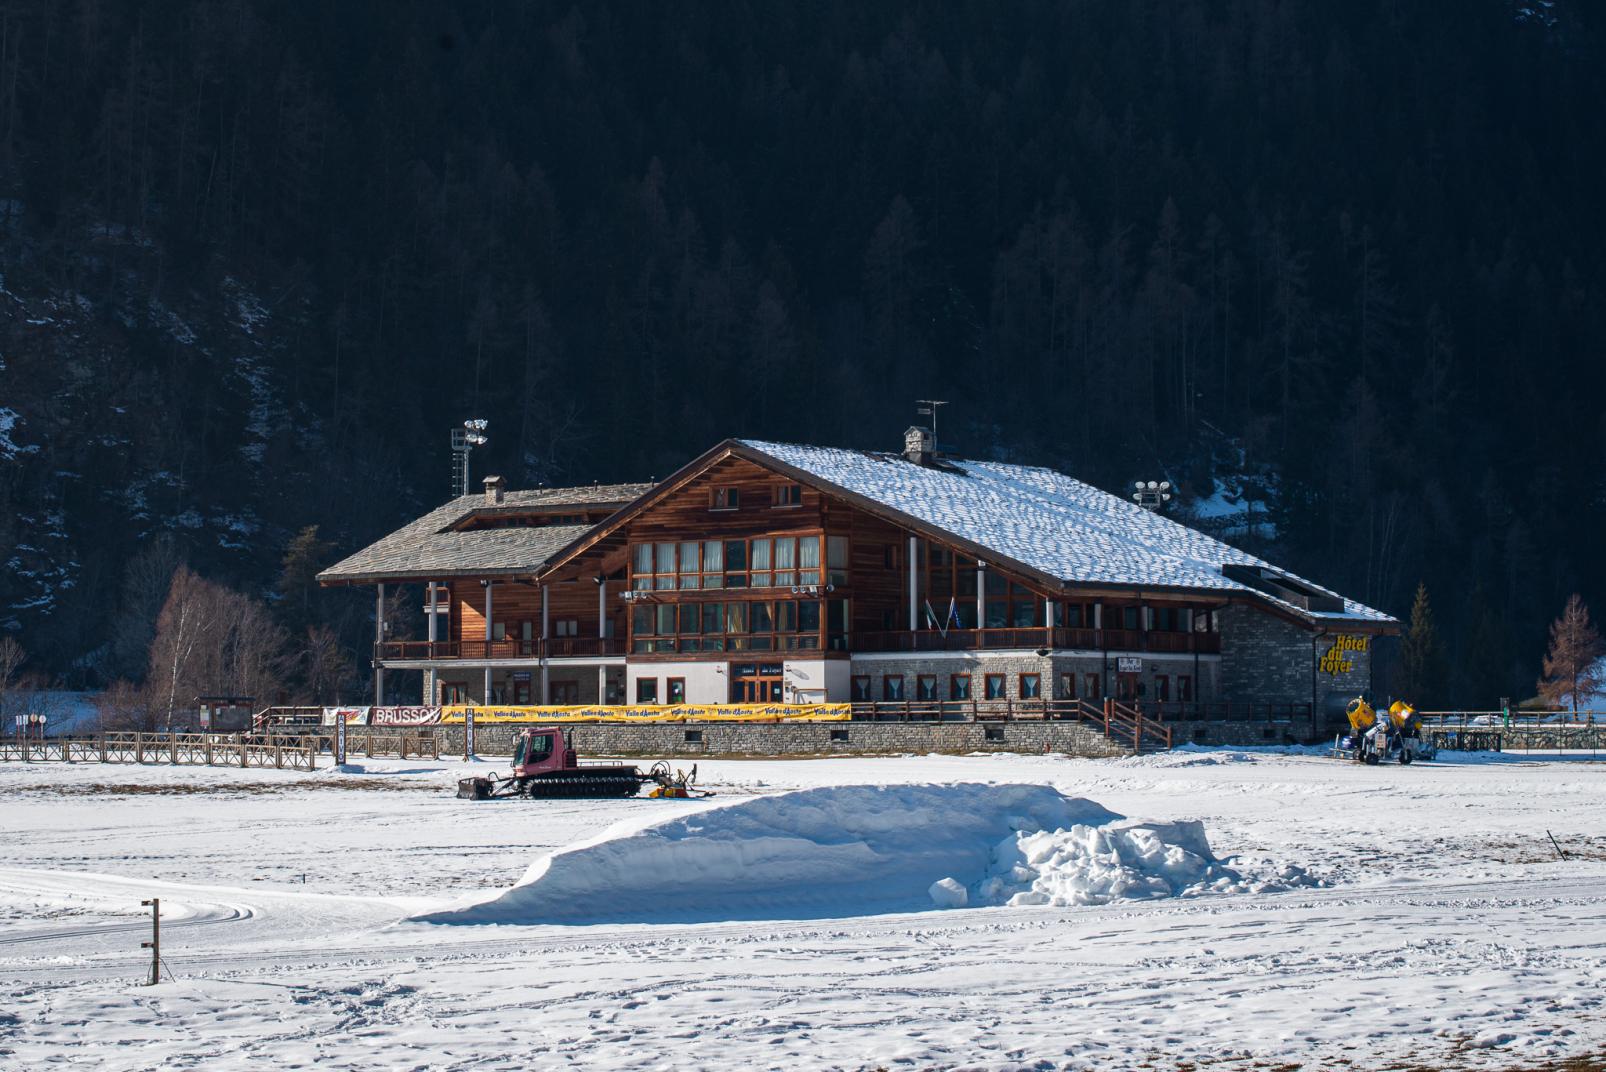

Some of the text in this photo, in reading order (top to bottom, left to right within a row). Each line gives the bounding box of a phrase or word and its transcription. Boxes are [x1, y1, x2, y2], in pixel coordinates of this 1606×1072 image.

[1336, 634, 1367, 651] Hôtel
[1327, 647, 1343, 661] du
[1319, 655, 1352, 675] Foyer
